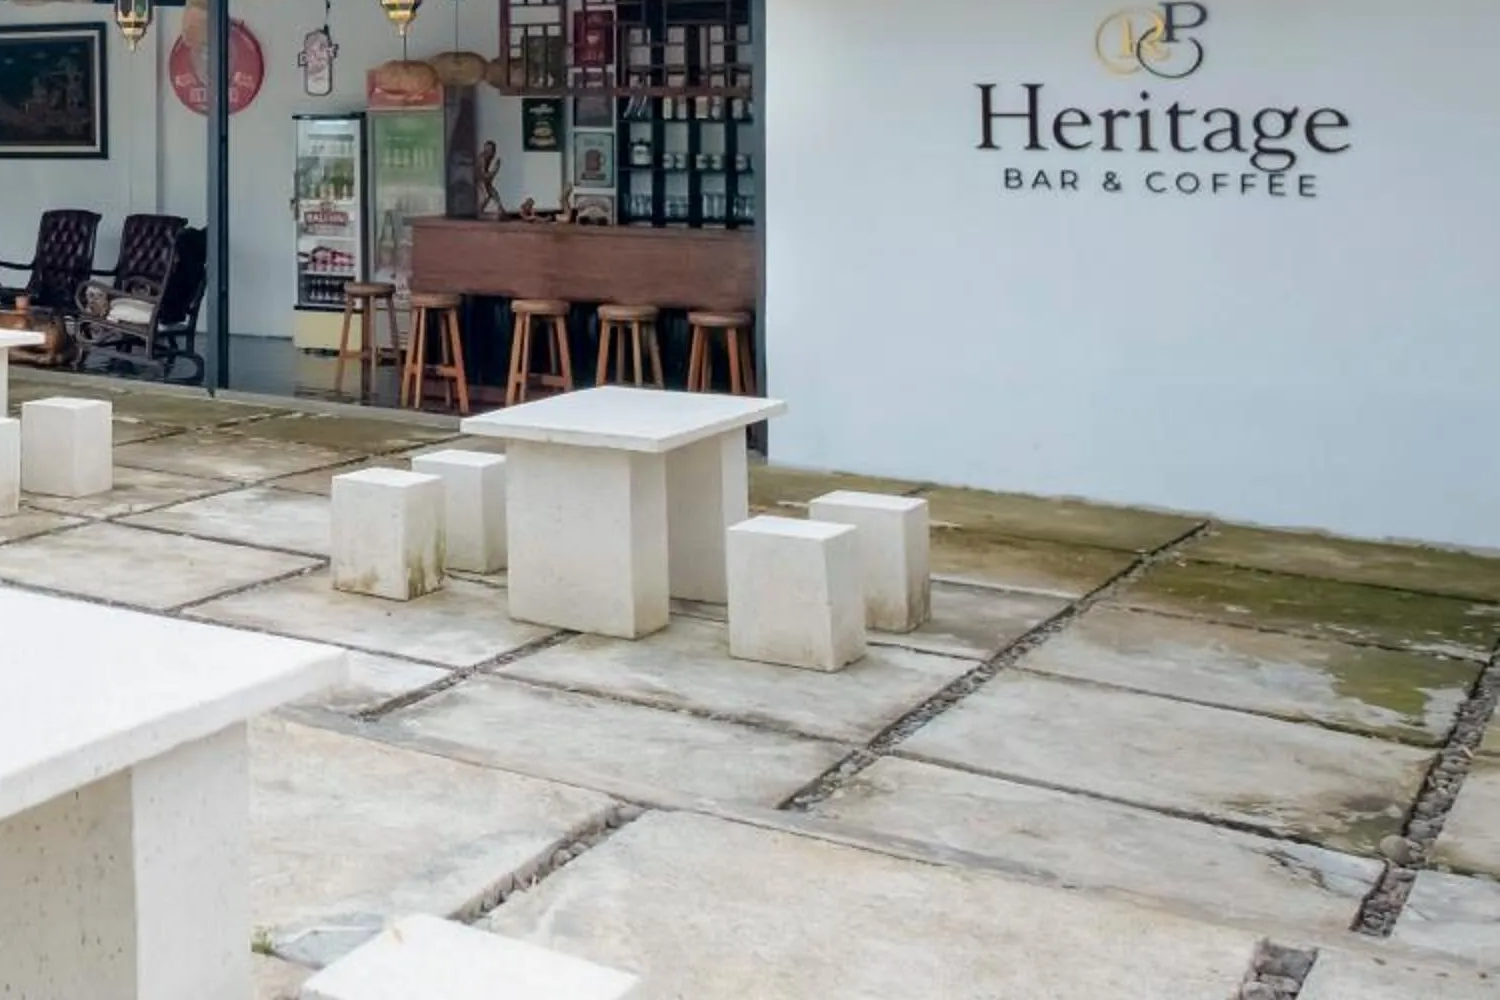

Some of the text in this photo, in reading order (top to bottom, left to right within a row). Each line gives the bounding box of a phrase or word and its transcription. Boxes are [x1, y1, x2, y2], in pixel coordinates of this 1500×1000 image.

[975, 82, 1352, 173] Heritage
[1003, 167, 1317, 198] BAR & COFFEE
